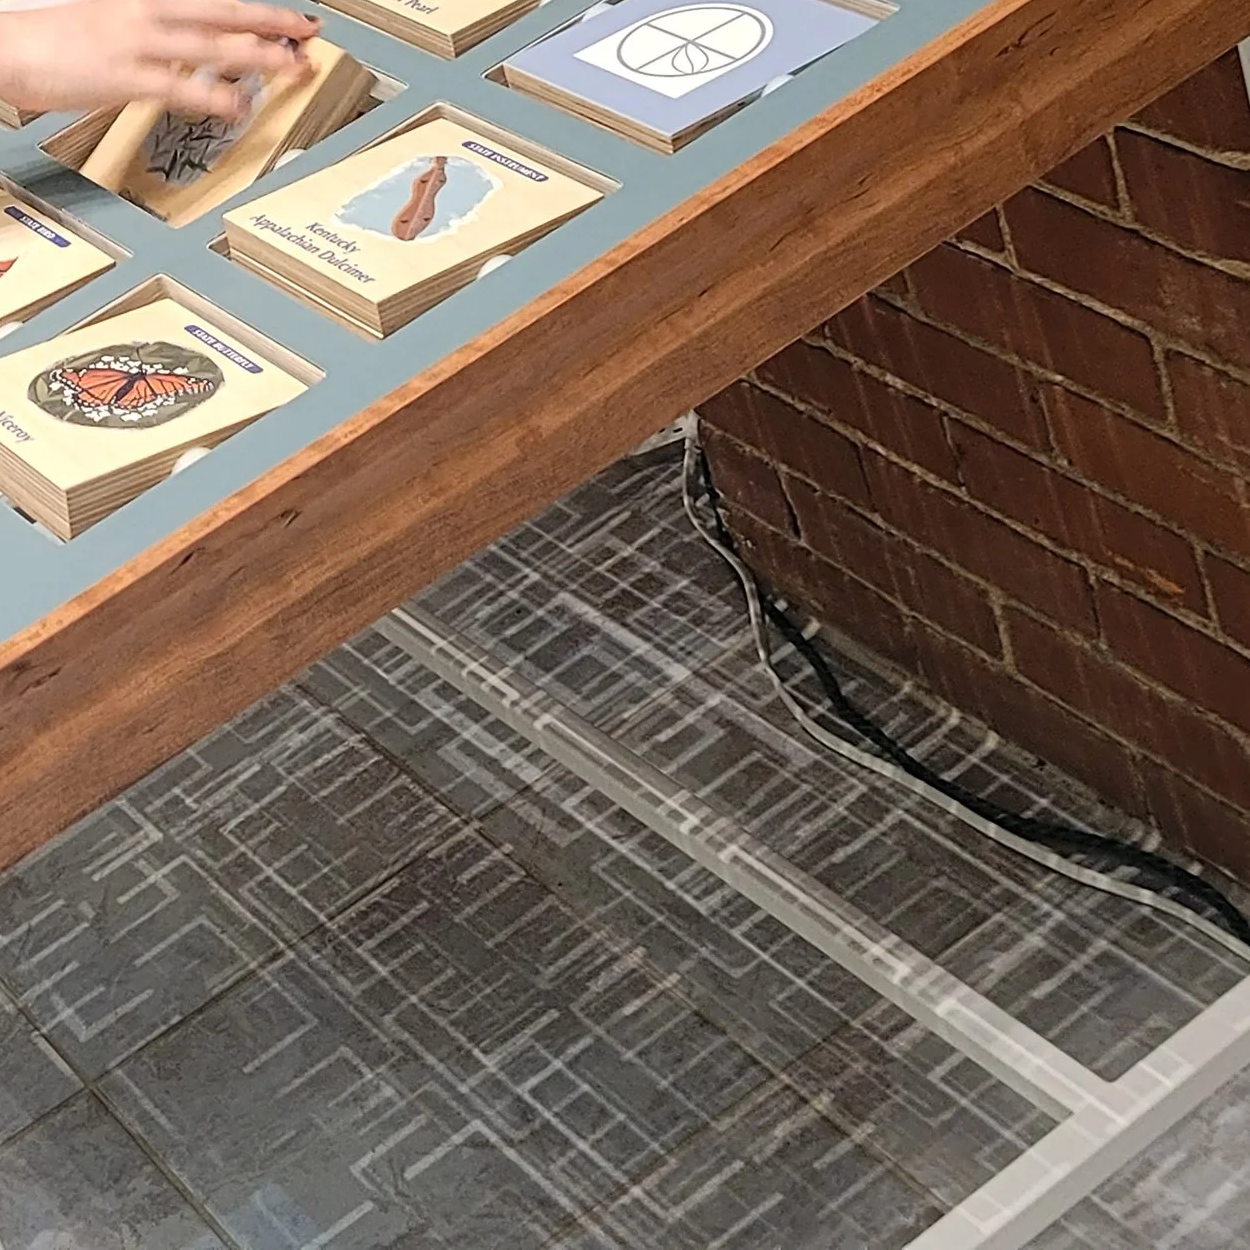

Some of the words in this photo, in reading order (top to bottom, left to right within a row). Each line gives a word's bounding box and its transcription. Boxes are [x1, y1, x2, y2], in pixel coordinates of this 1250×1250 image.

[468, 141, 493, 160] STATE
[489, 151, 545, 182] INSTRUMENT
[19, 214, 41, 232] STATE
[305, 221, 362, 255] Kentucky
[250, 213, 320, 255] Appalachian
[317, 247, 377, 285] Dulcimer
[192, 328, 215, 348] STATE
